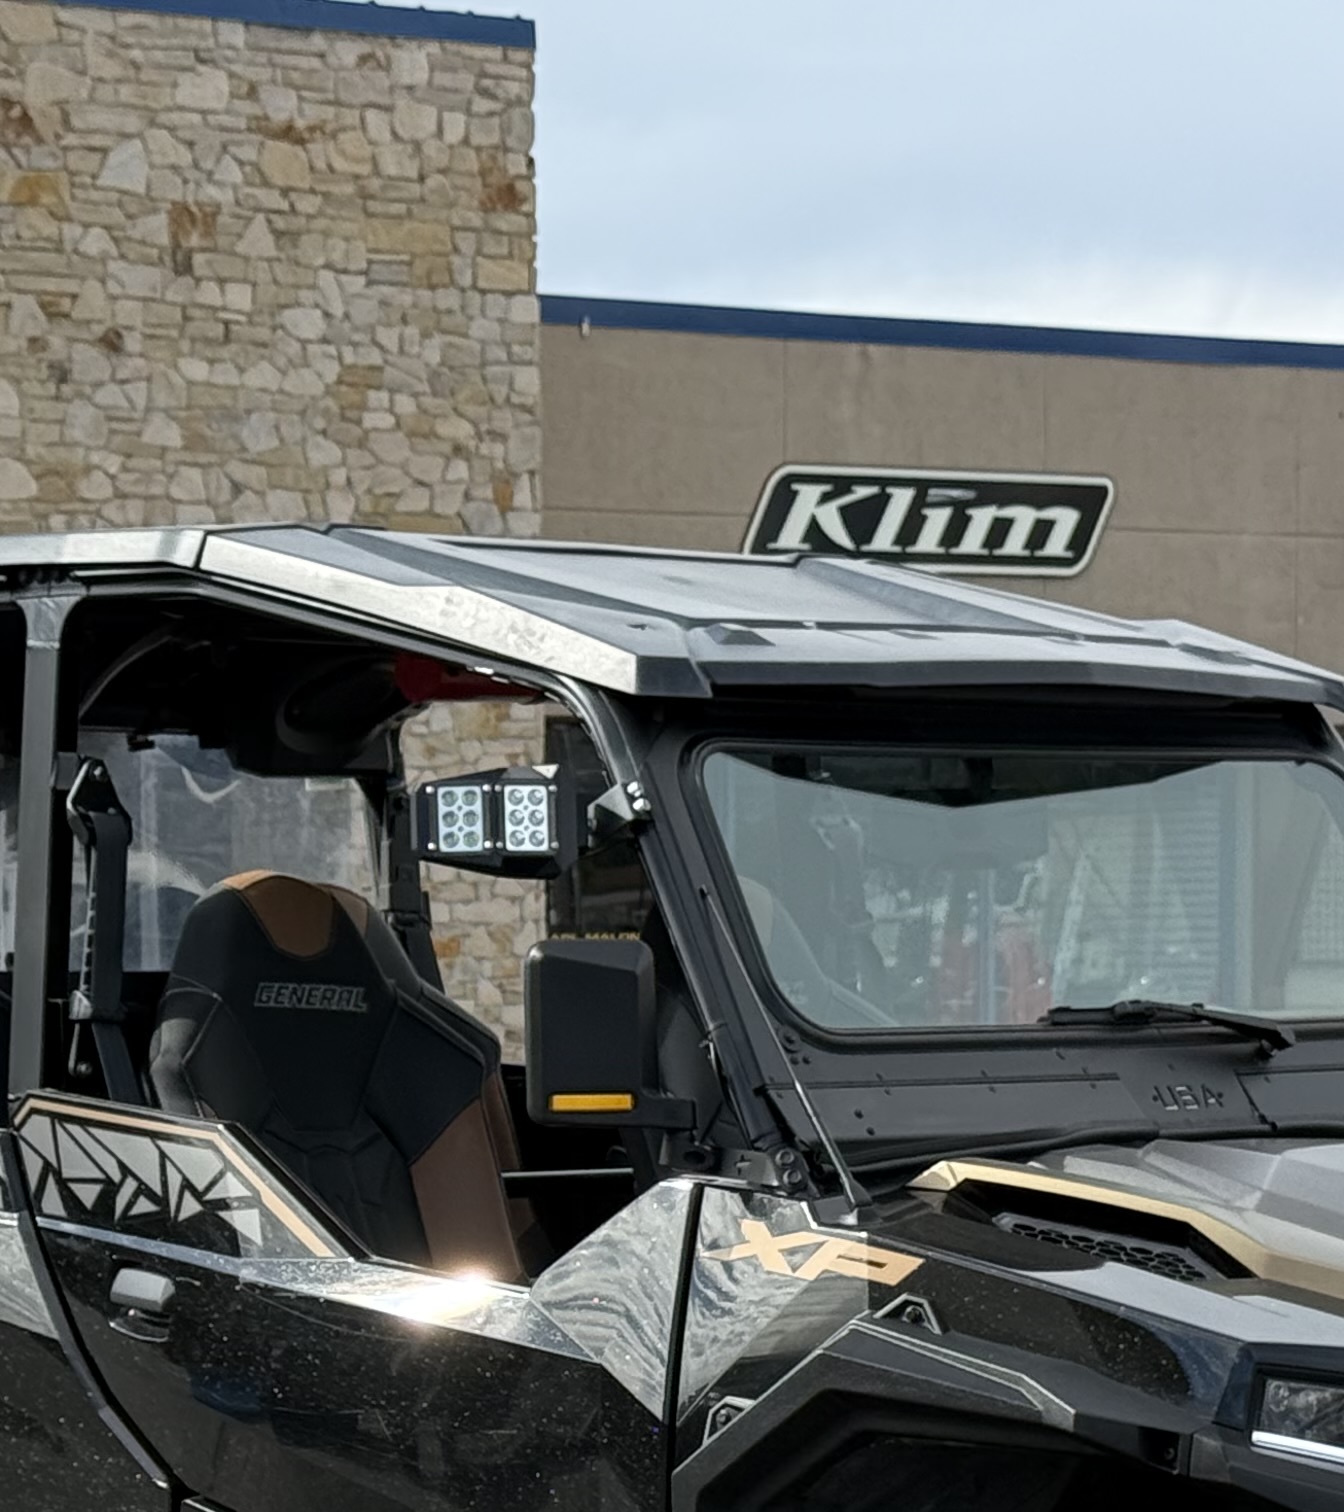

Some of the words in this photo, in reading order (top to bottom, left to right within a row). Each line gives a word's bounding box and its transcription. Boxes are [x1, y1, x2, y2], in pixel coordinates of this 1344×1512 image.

[766, 482, 1082, 558] Klim
[253, 981, 368, 1013] GENERAL
[1153, 1084, 1223, 1111] USA
[700, 1218, 926, 1286] XP
